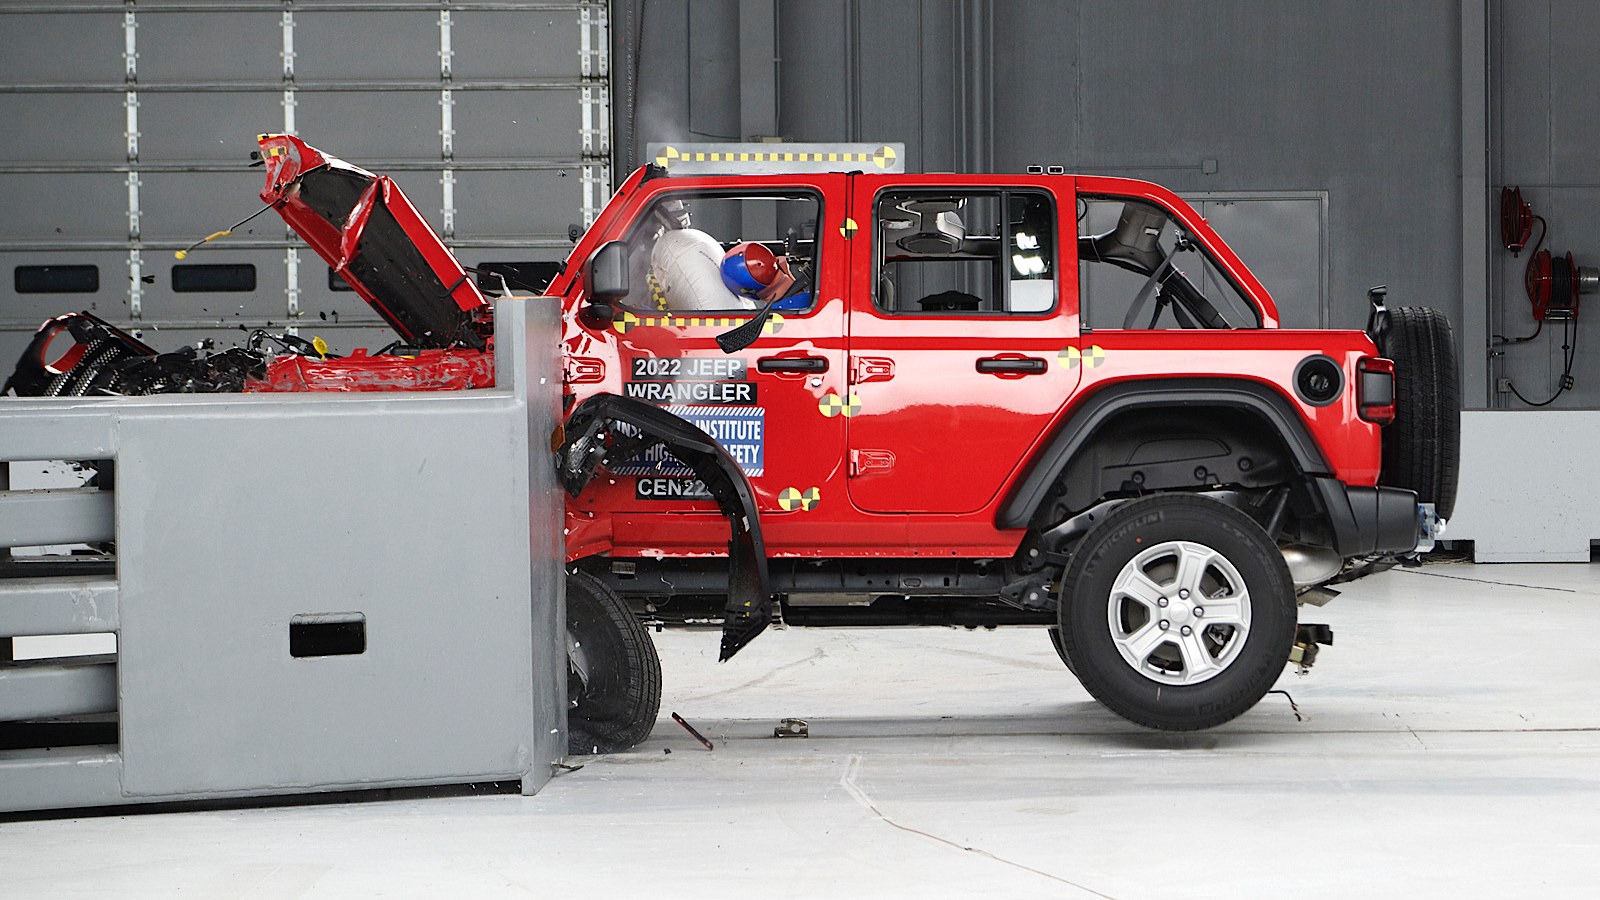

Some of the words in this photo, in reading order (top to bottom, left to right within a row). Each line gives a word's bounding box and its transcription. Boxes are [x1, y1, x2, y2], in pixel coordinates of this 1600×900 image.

[635, 359, 681, 376] 2022
[687, 359, 741, 376] JEEP
[627, 383, 751, 401] WRANGLER
